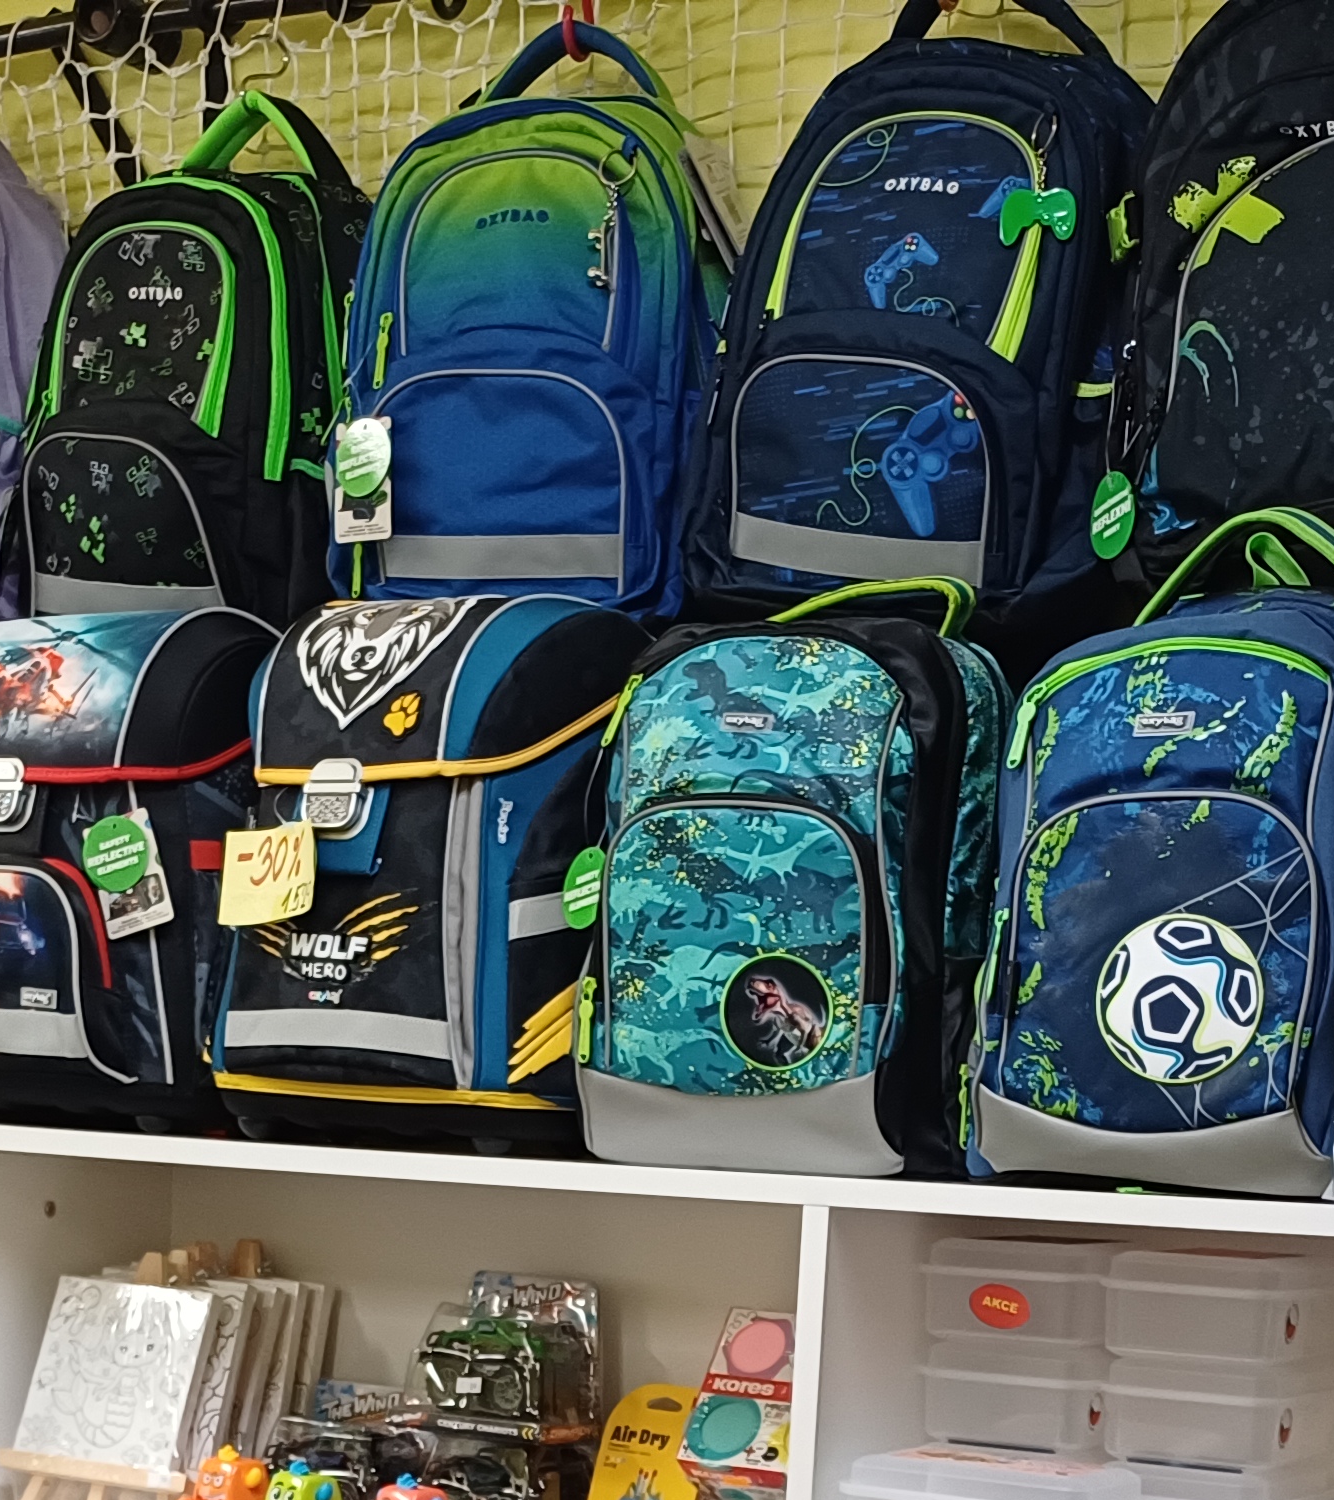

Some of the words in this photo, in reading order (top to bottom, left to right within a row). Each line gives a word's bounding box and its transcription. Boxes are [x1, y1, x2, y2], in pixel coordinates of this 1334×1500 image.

[884, 177, 959, 194] OXYBAG
[476, 209, 550, 229] OXYBAG
[128, 287, 183, 301] OXYBAG
[291, 933, 369, 960] WOLF
[301, 962, 348, 980] HERO
[982, 1295, 1018, 1315] AKCE
[713, 1377, 775, 1397] Kores
[611, 1425, 638, 1443] Air
[639, 1430, 670, 1450] Dry
